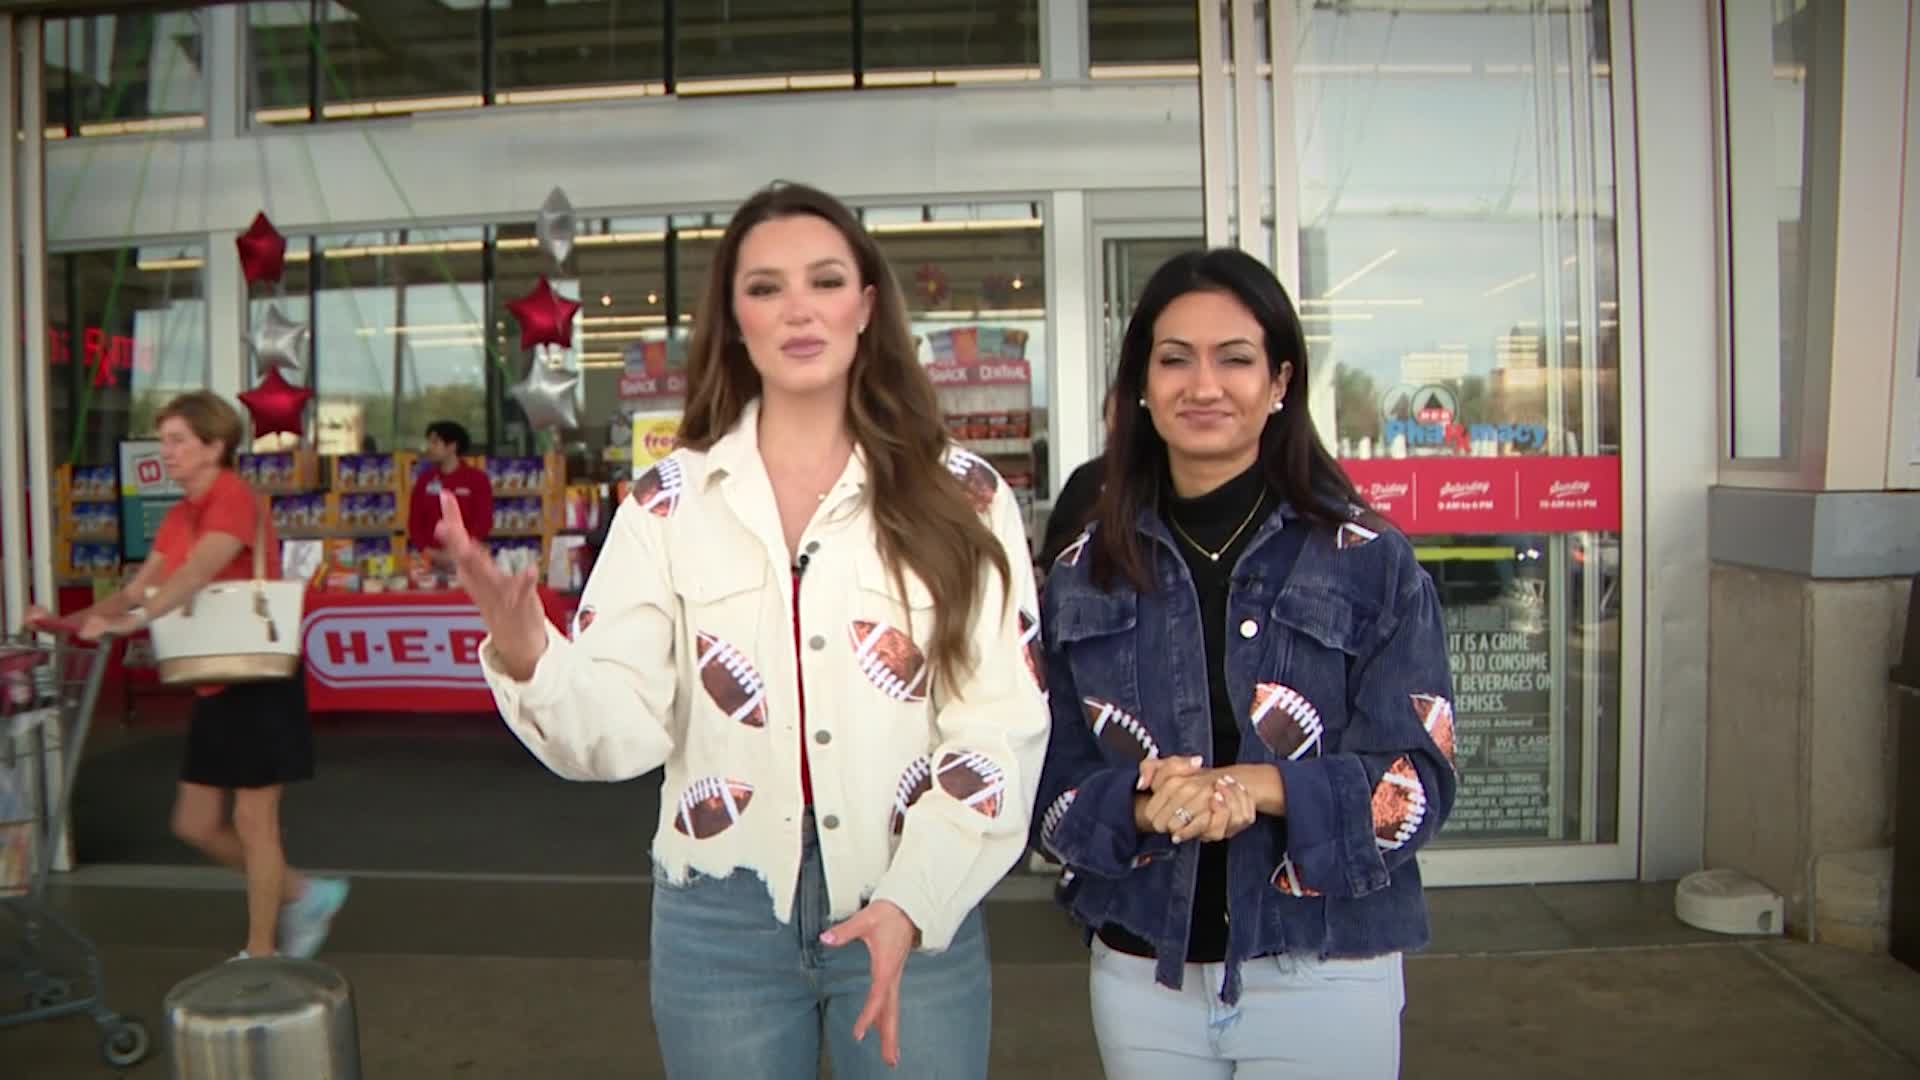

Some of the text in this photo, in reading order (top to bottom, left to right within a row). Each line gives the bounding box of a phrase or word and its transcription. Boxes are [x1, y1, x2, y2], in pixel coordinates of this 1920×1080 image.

[1440, 481, 1489, 497] Saturday
[1550, 480, 1590, 496] Sunday
[1446, 502, 1460, 512] AM
[1479, 501, 1493, 511] PM
[1551, 500, 1565, 510] AM
[1584, 500, 1597, 510] PM
[1449, 632, 1529, 652] IT IS A CRIME
[1470, 654, 1486, 672] TO
[1488, 652, 1548, 671] CONSUME
[1462, 673, 1533, 692] BEVERAGES
